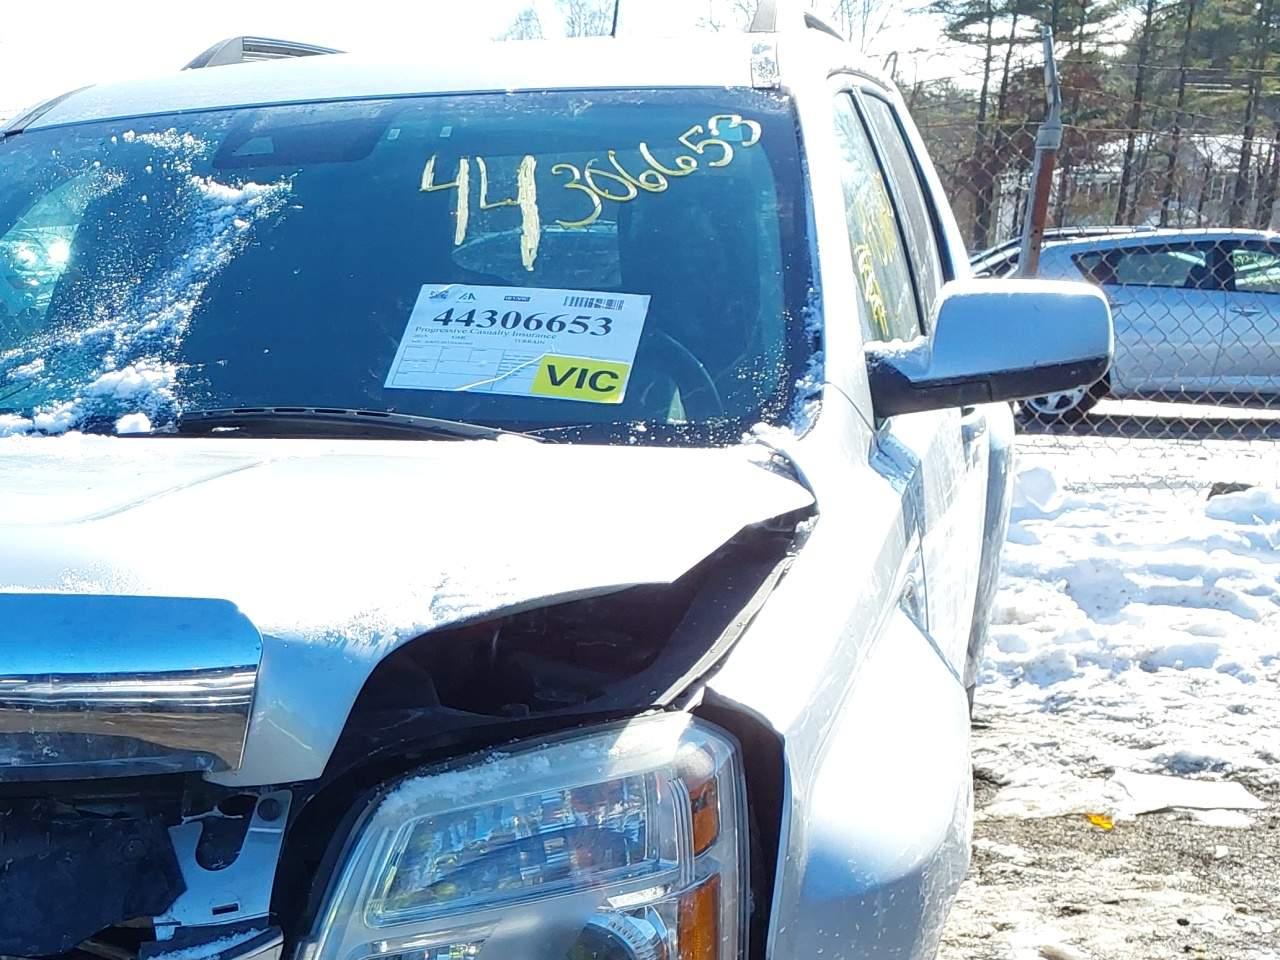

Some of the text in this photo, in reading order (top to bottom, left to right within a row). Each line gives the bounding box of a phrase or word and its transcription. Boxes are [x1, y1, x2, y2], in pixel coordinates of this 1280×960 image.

[415, 326, 557, 340] Progressive Casualty Insurance
[432, 308, 614, 337] 44306653
[546, 364, 620, 393] VIC
